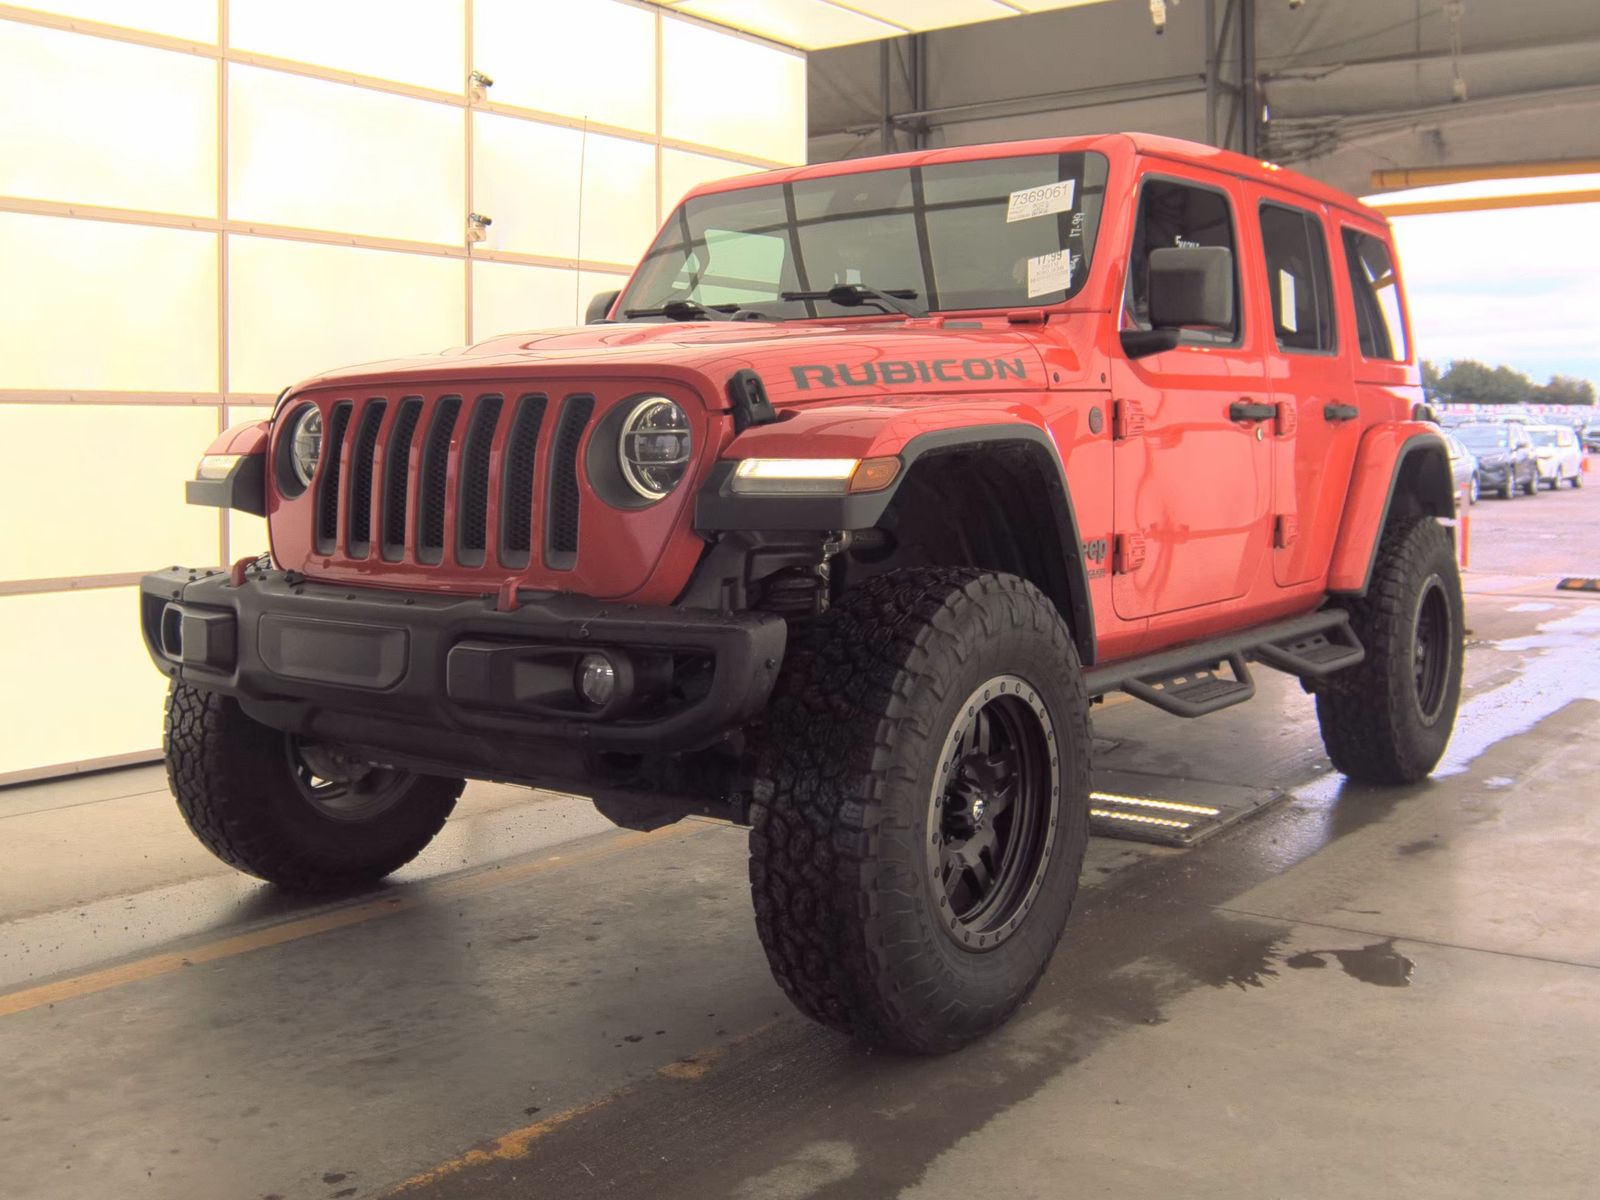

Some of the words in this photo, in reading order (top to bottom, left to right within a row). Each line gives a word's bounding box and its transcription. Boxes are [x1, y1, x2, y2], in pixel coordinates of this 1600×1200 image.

[1012, 185, 1067, 207] 7369061
[790, 358, 1027, 391] RUBICON
[1082, 539, 1107, 564] eep
